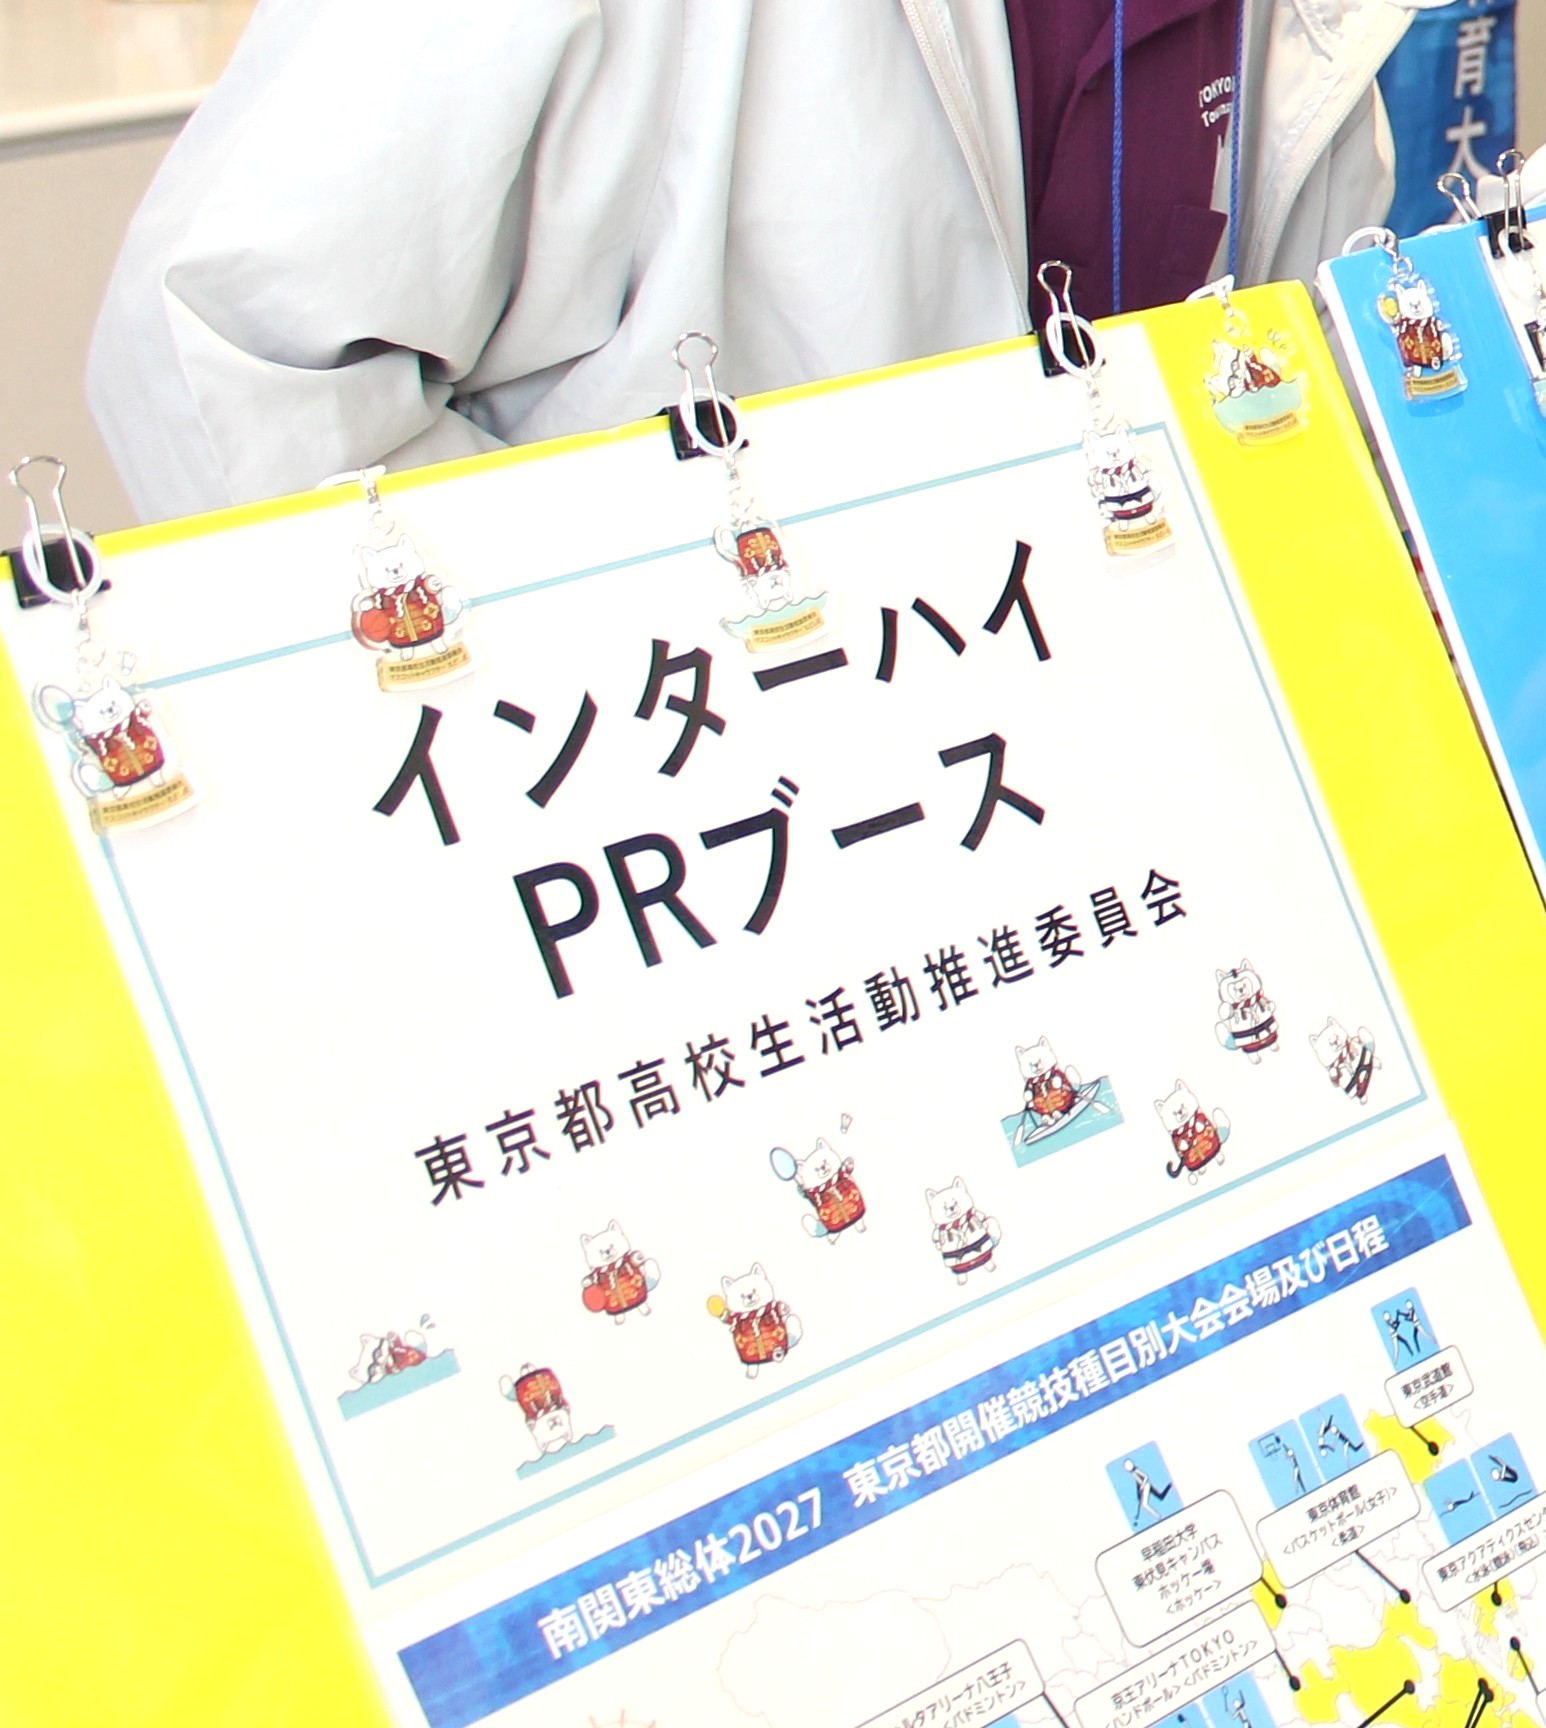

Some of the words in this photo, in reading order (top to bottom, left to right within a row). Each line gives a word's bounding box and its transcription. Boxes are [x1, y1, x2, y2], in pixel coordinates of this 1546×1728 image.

[373, 540, 1052, 846] インターハイ
[512, 732, 1047, 999] PRブース
[414, 868, 1189, 1207] 東京都高校生活動推進委員会
[538, 1487, 824, 1661] 南関東総体2027
[842, 1214, 1390, 1508] 東京都開催競技種目別大会会場及び日程
